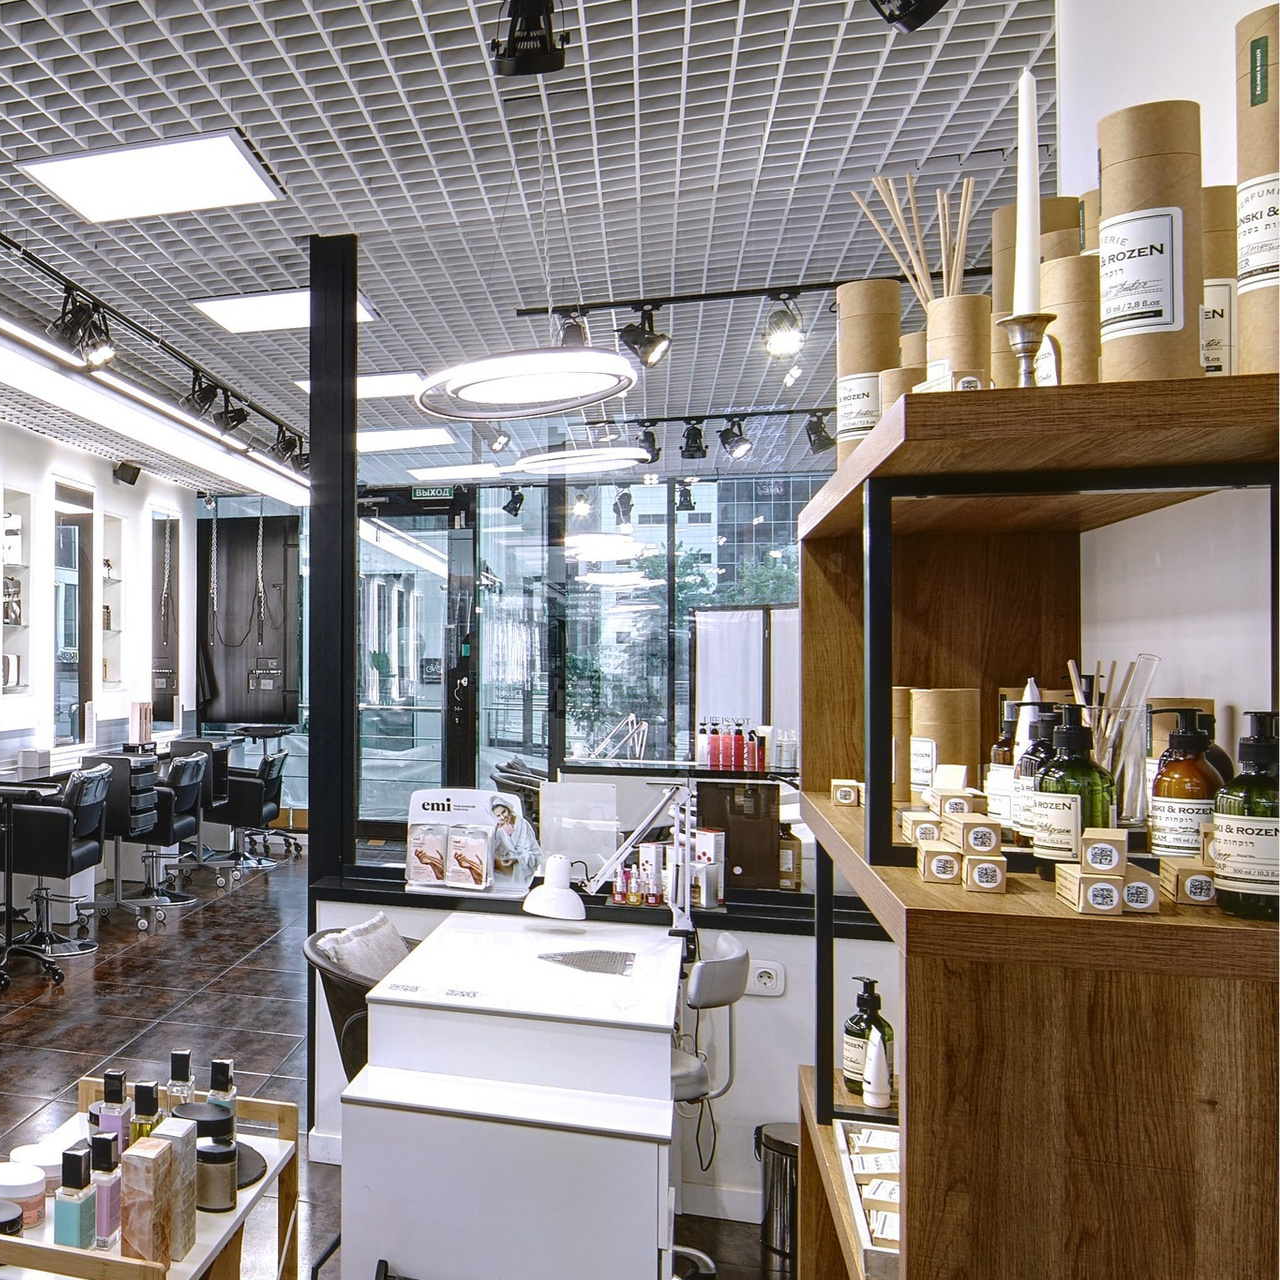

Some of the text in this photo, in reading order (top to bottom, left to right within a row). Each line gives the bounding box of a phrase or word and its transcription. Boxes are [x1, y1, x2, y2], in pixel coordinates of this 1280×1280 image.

[1108, 243, 1164, 265] ROZEN
[843, 392, 870, 402] ROZEN
[416, 488, 450, 496] ВЫХОД
[422, 798, 452, 812] emi
[1038, 802, 1072, 810] ROZEN
[1225, 824, 1233, 833] &
